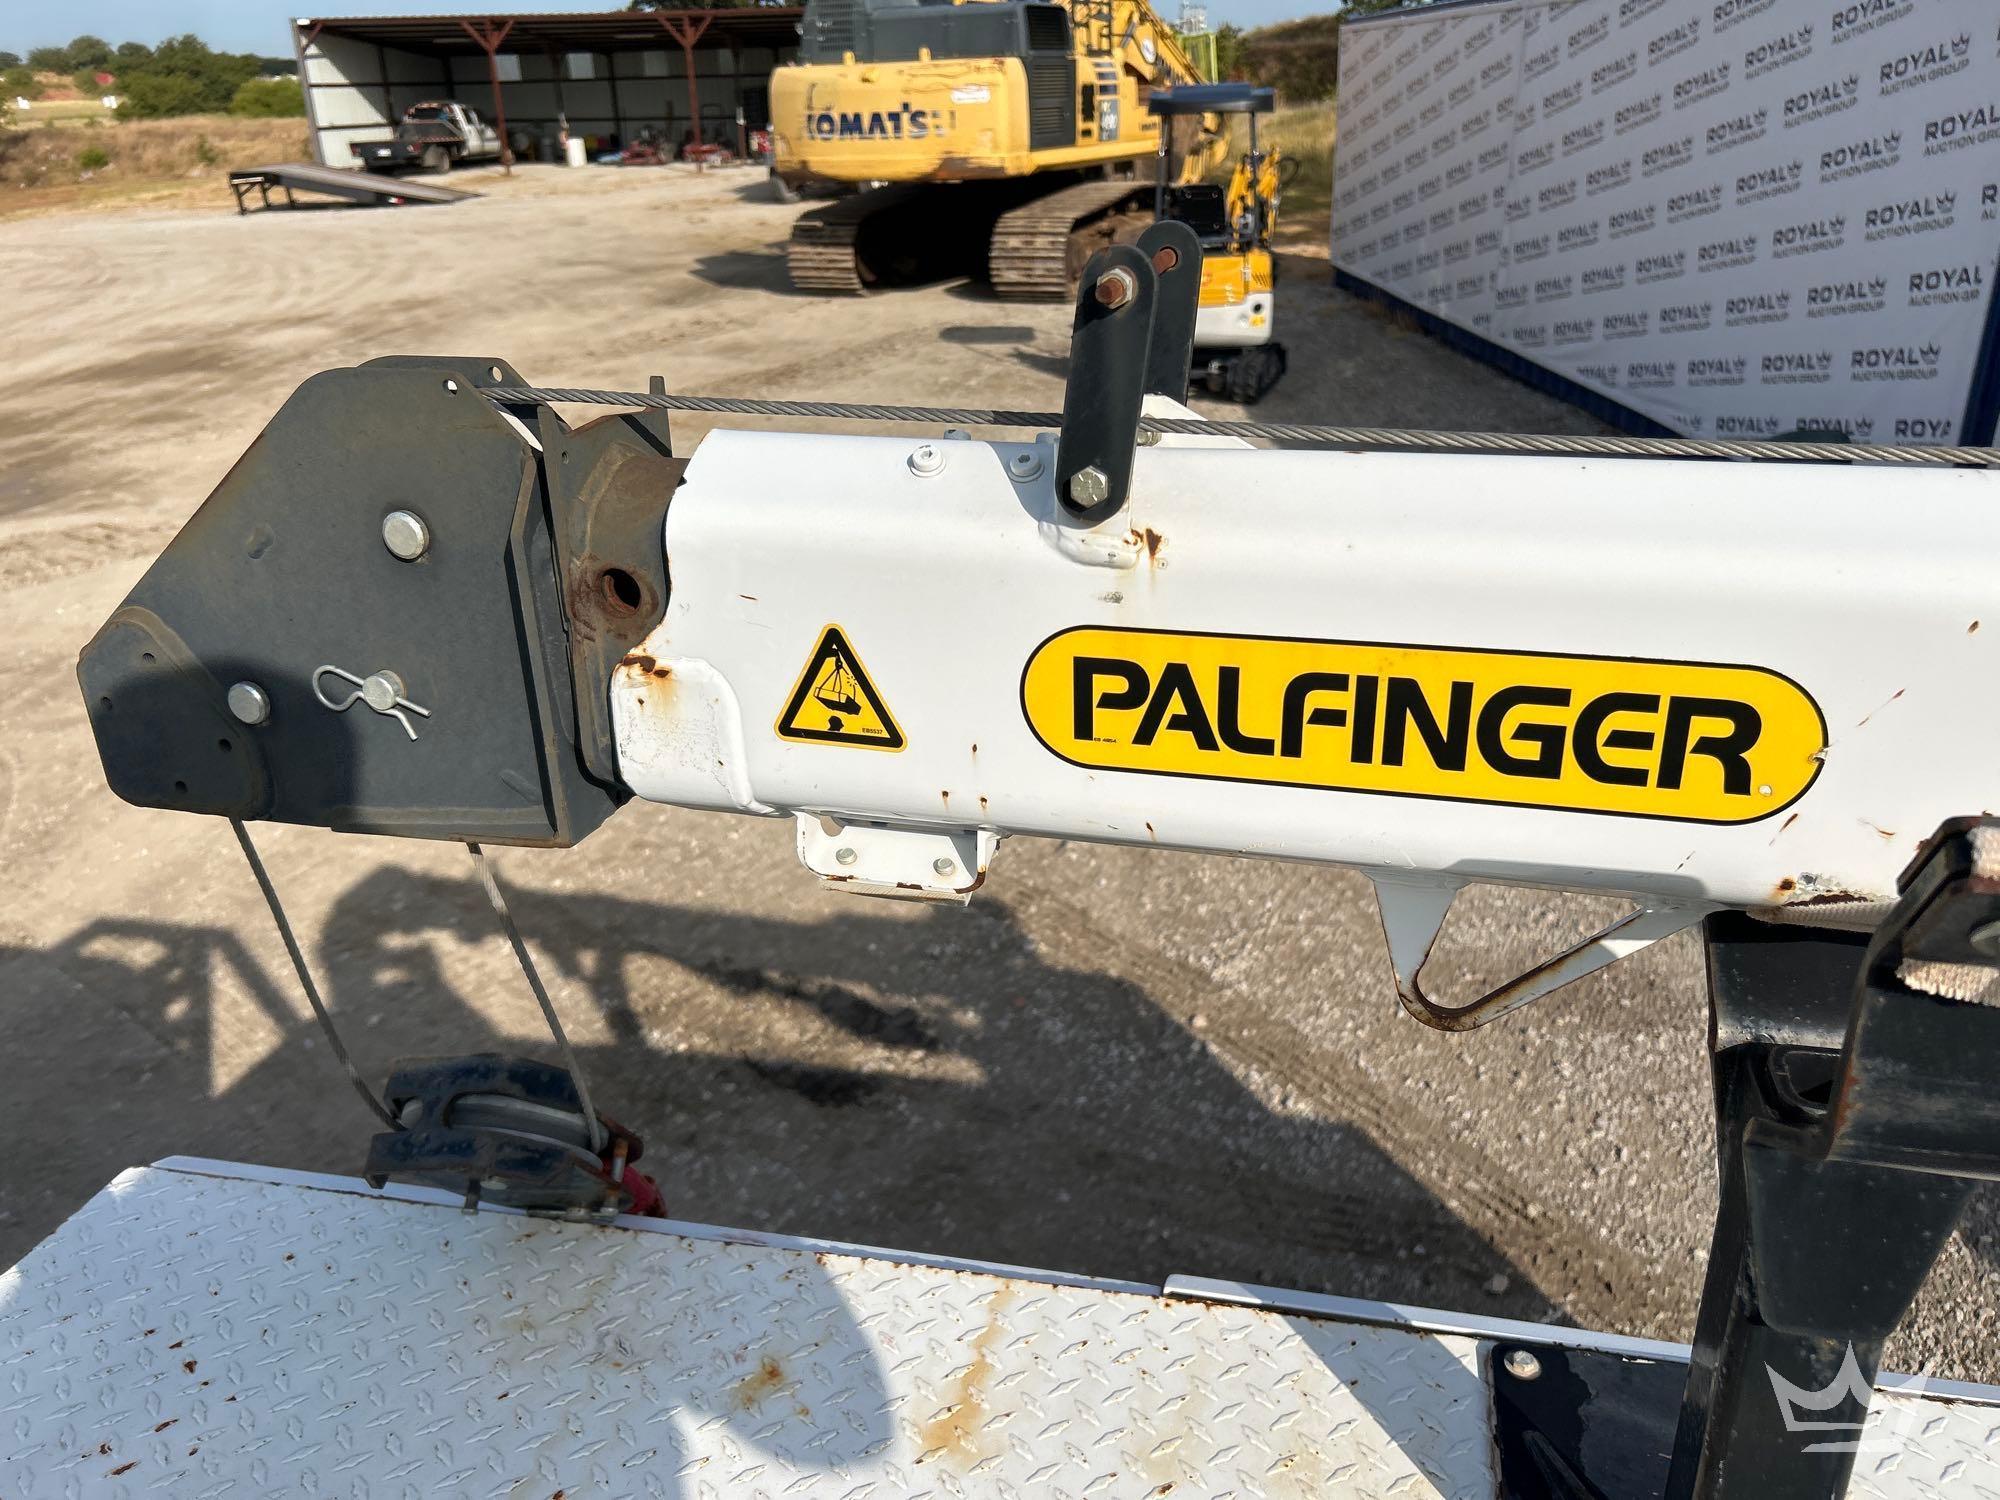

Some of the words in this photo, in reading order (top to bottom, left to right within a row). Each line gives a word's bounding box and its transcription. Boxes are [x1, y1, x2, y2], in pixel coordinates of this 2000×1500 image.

[1745, 33, 1797, 68] ROYAL
[1880, 43, 1949, 82] ROYAL
[1673, 69, 1717, 99] ROYAL
[1880, 72, 1926, 96] AUCTION
[1927, 58, 1970, 81] GROUP
[1784, 82, 1841, 116] ROYAL
[1706, 114, 1753, 143] ROYAL
[1925, 105, 2000, 141] ROYAL
[1642, 142, 1681, 165] ROYAL
[1820, 137, 1882, 170] ROYAL
[1924, 135, 1976, 157] AUCTION
[1736, 165, 1786, 193] ROYAL
[1667, 189, 1709, 213] ROYAL
[1866, 197, 1934, 228] ROYAL
[1773, 220, 1828, 246] ROYAL
[1865, 223, 1911, 241] AUCTION
[1912, 216, 1954, 234] GROUP
[1698, 239, 1743, 262] ROYAL
[1636, 254, 1673, 273] ROYAL
[1909, 265, 1982, 292] ROYAL
[1726, 295, 1775, 315] ROYAL
[1807, 282, 1867, 304] ROYAL
[1660, 305, 1699, 323] ROYAL
[1688, 358, 1732, 375] ROYAL
[1761, 353, 1815, 372] ROYAL
[1851, 347, 1919, 368] ROYAL
[1716, 416, 1764, 433] ROYAL
[1073, 656, 1762, 797] PALFINGER
